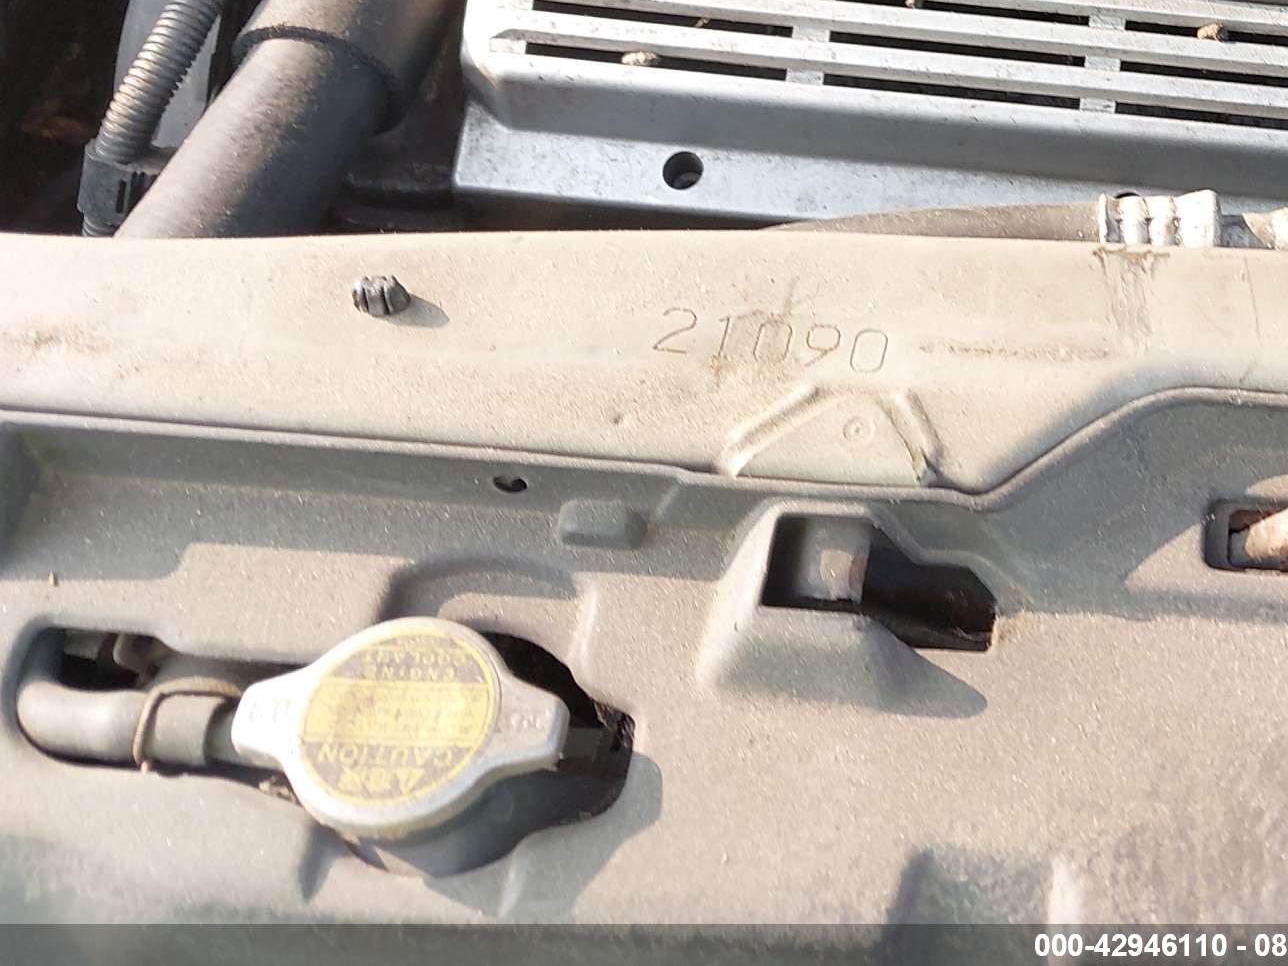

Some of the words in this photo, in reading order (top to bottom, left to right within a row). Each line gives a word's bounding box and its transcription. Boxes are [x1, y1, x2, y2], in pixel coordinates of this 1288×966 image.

[653, 307, 888, 374] 21090
[366, 665, 455, 681] ENGINE
[317, 743, 453, 767] CAUTION
